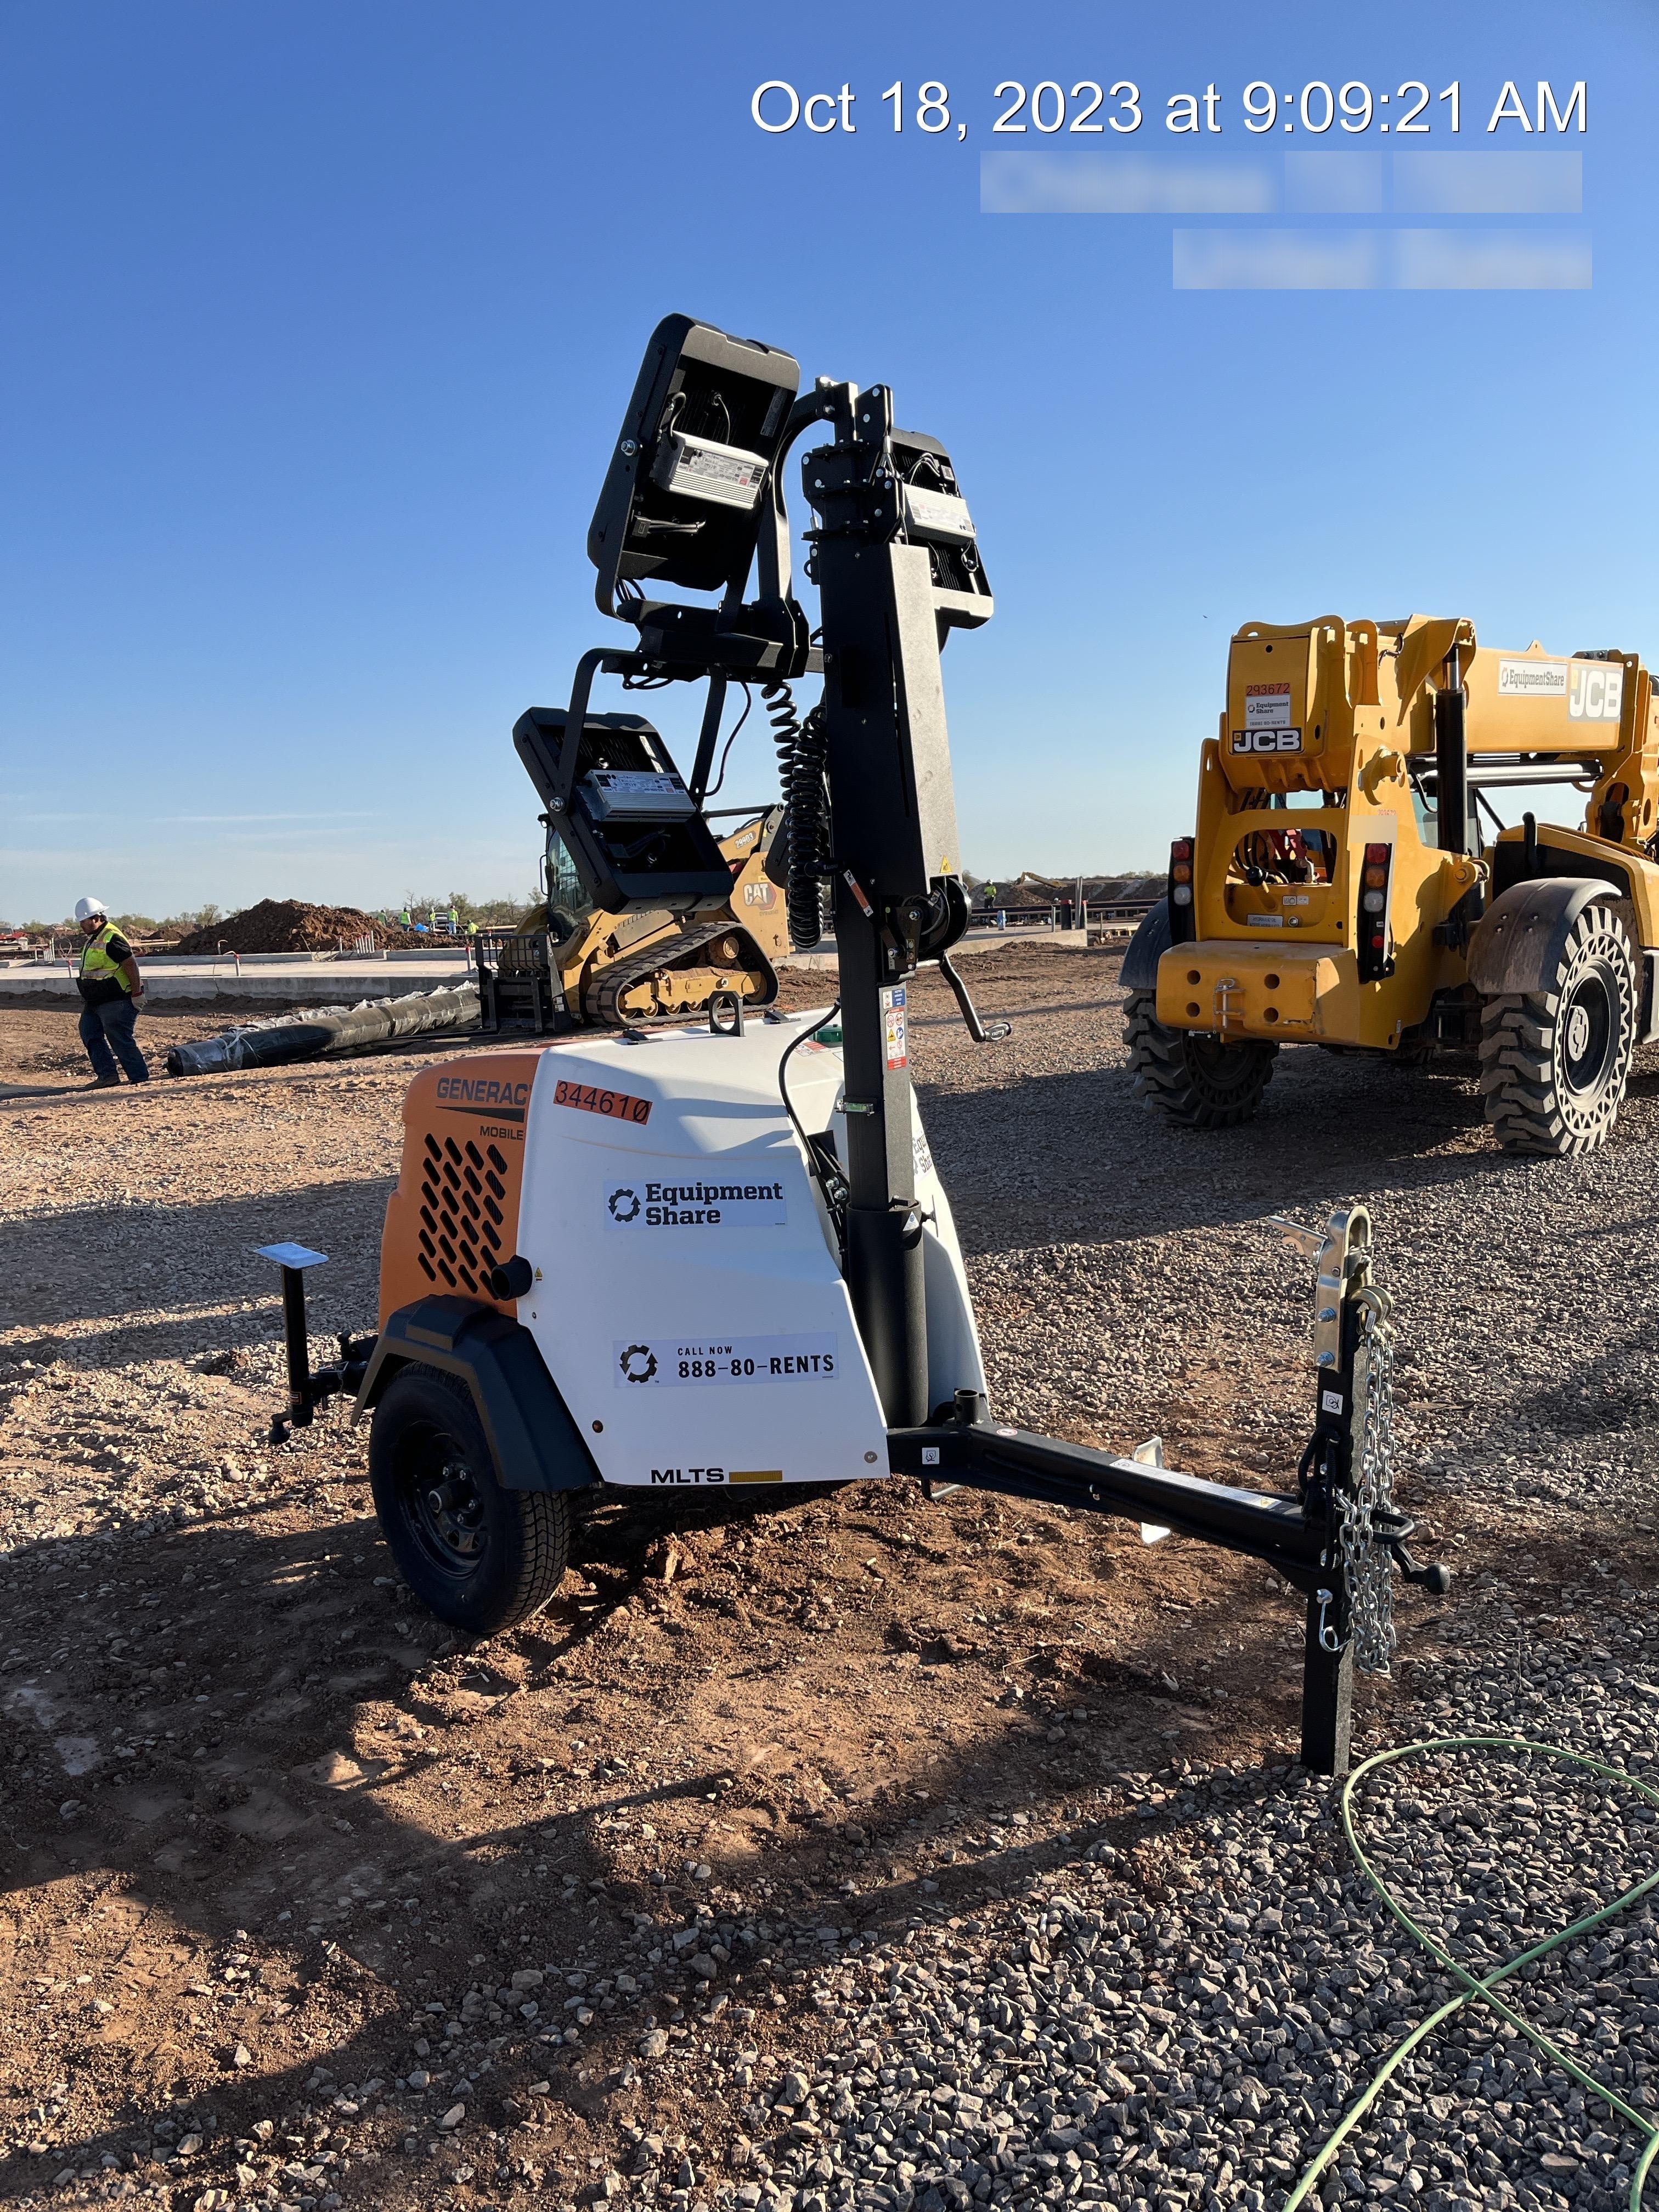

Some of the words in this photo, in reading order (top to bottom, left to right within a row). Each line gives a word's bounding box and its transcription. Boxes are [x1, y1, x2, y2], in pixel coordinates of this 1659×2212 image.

[1246, 682, 1290, 696] 293672
[1509, 669, 1564, 689] EquipmentShare
[1570, 670, 1622, 718] JCB
[1234, 730, 1300, 752] JCB
[735, 832, 754, 849] 29903
[743, 883, 769, 905] CAT
[437, 1077, 528, 1106] GENERAC
[555, 1080, 652, 1122] 344610
[479, 1125, 524, 1141] MOBILE
[645, 1182, 783, 1206] Equipment
[645, 1206, 721, 1226] Share
[678, 1347, 704, 1356] CALL
[709, 1345, 732, 1355] NOW
[678, 1354, 834, 1378] 888-80-RENTS
[651, 1468, 724, 1483] MLTS
